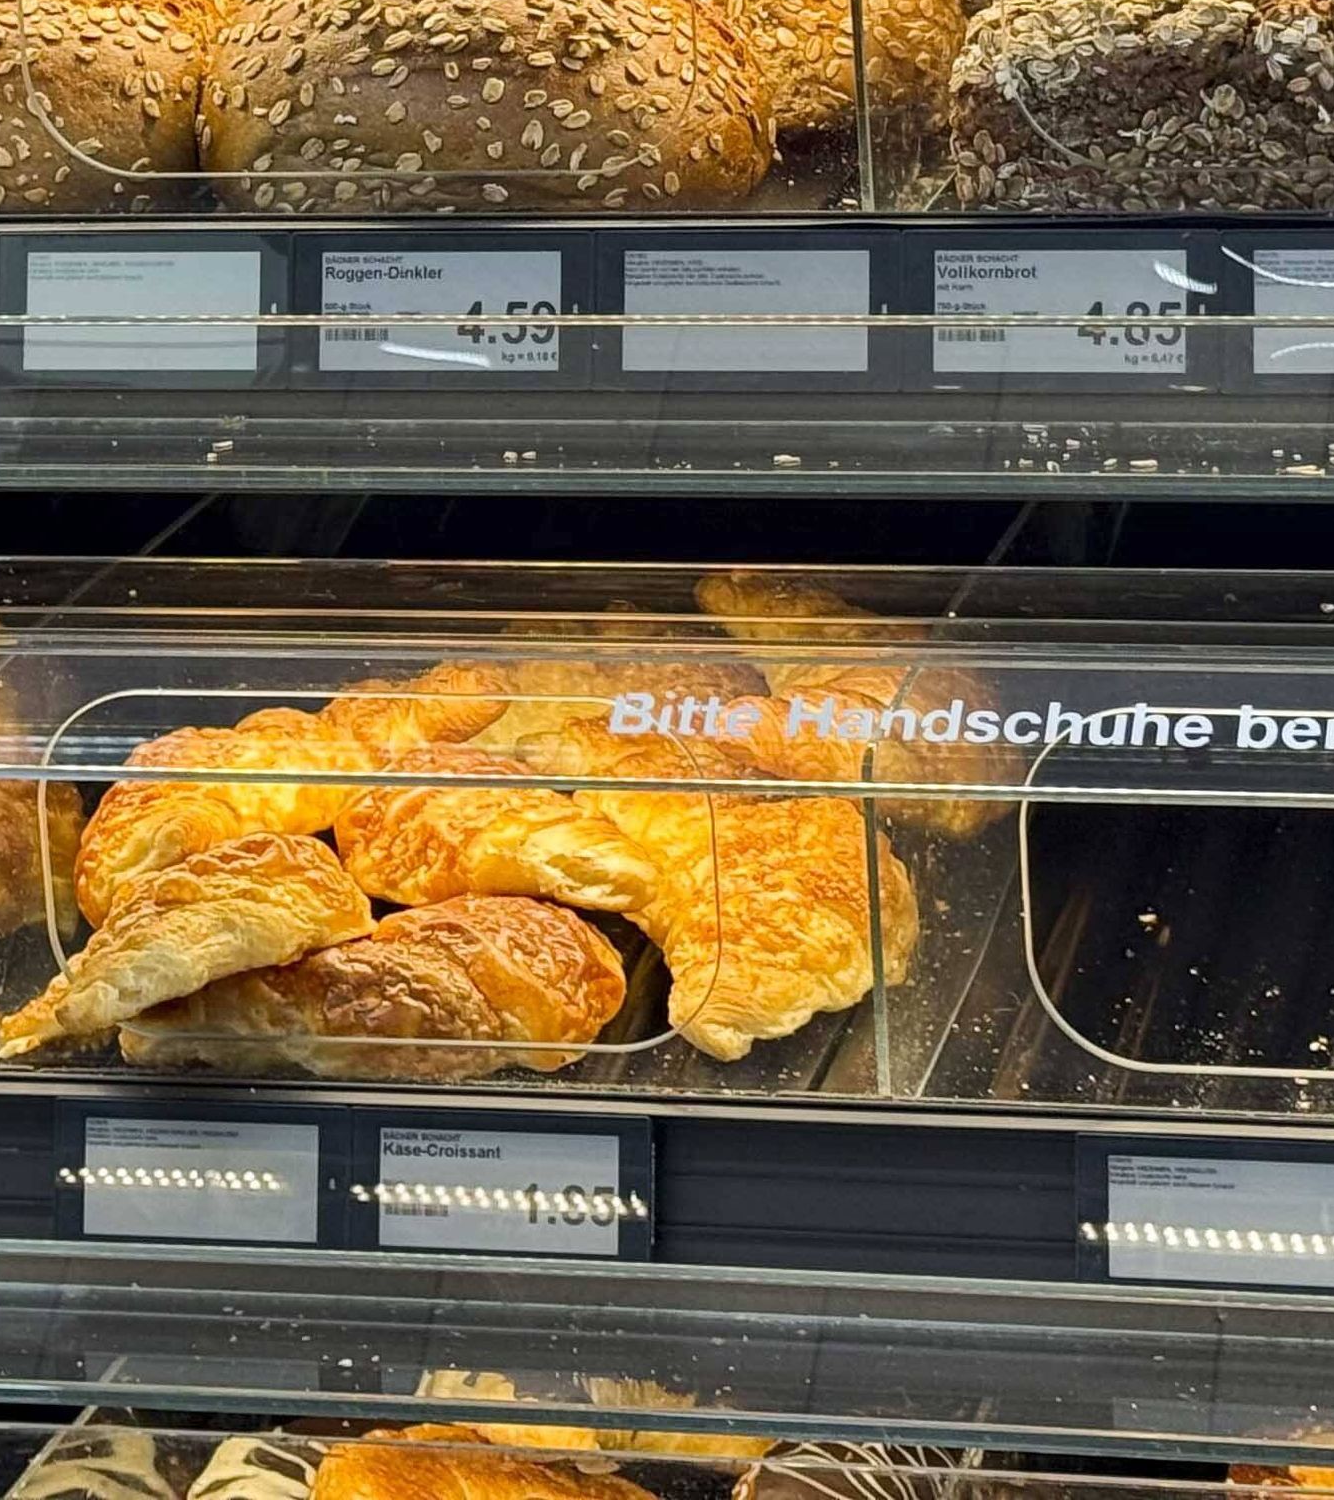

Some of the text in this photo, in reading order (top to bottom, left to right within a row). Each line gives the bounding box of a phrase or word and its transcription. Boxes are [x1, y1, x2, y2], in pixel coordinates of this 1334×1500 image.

[325, 266, 443, 283] Roggen-Dinkler
[937, 265, 1037, 279] Vollkornbrot
[457, 301, 556, 344] 4.59
[1078, 301, 1182, 345] 4.85
[501, 352, 515, 363] kg
[1124, 354, 1139, 365] kg
[608, 691, 762, 738] Bitte
[785, 695, 1212, 750] Handschuhe
